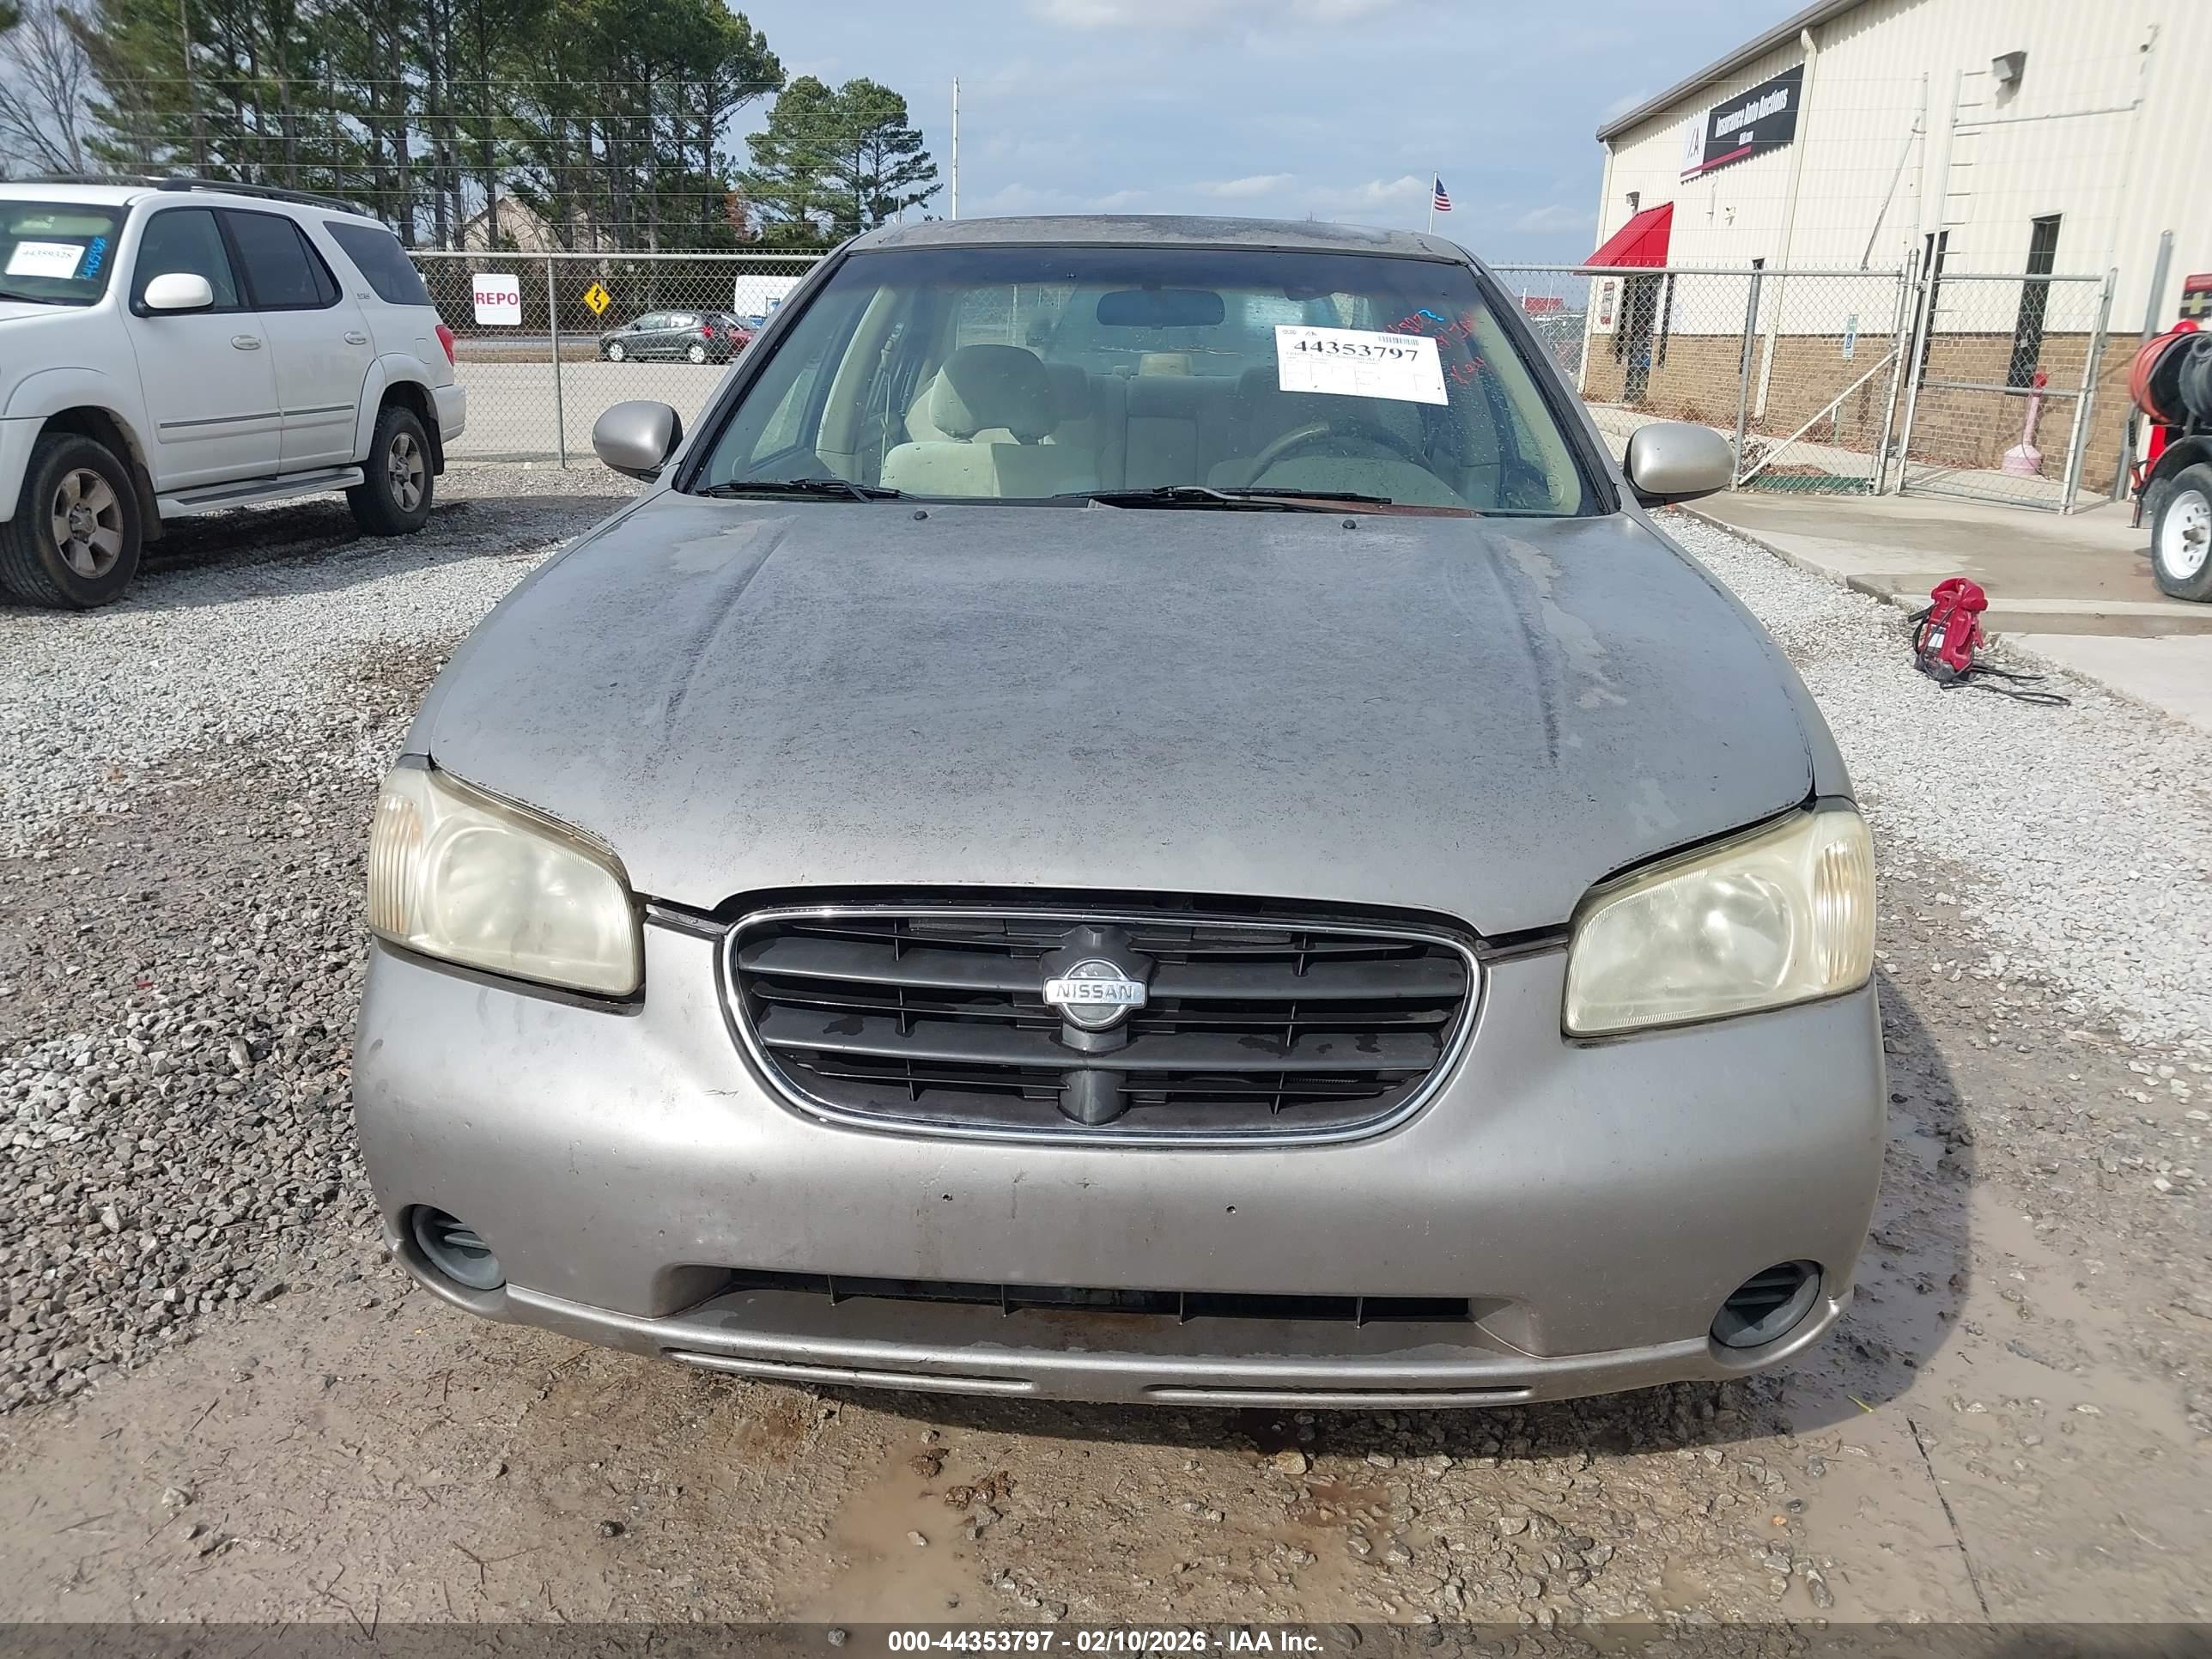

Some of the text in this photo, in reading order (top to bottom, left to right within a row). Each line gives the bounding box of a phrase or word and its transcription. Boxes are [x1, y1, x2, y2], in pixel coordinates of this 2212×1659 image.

[1715, 107, 1745, 138] Insurance
[1744, 100, 1760, 126] Auto
[1758, 88, 1789, 119] Auctions
[475, 292, 519, 306] REPO
[1293, 340, 1419, 362] 44353797
[1056, 983, 1133, 1000] NISSAN
